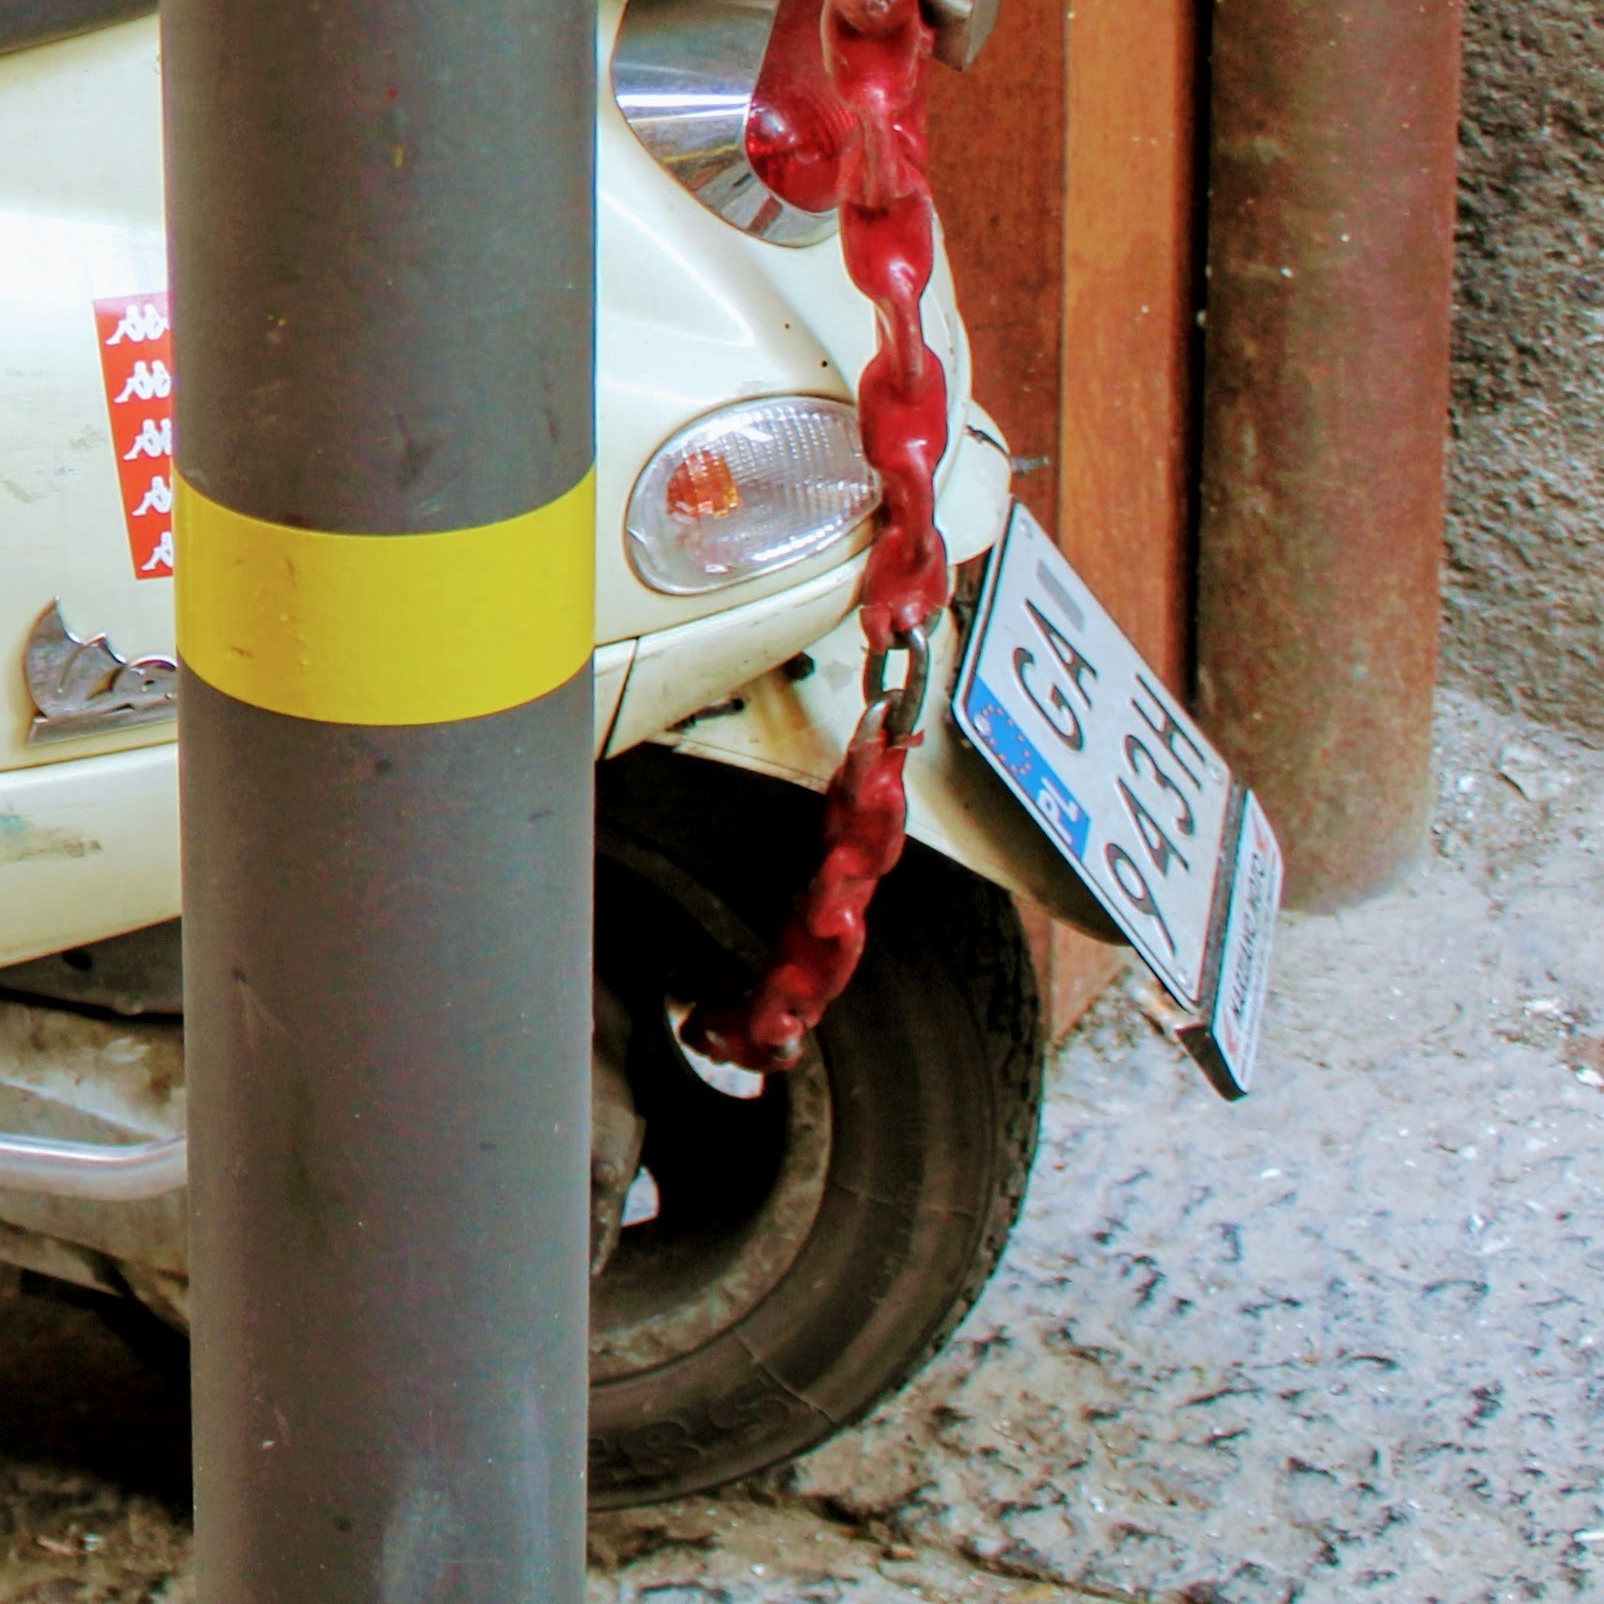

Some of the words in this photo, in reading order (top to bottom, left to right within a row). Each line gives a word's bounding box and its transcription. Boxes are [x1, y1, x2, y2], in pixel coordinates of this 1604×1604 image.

[1012, 598, 1098, 753] GA
[1038, 777, 1080, 845] PL
[1104, 671, 1208, 958] 943H
